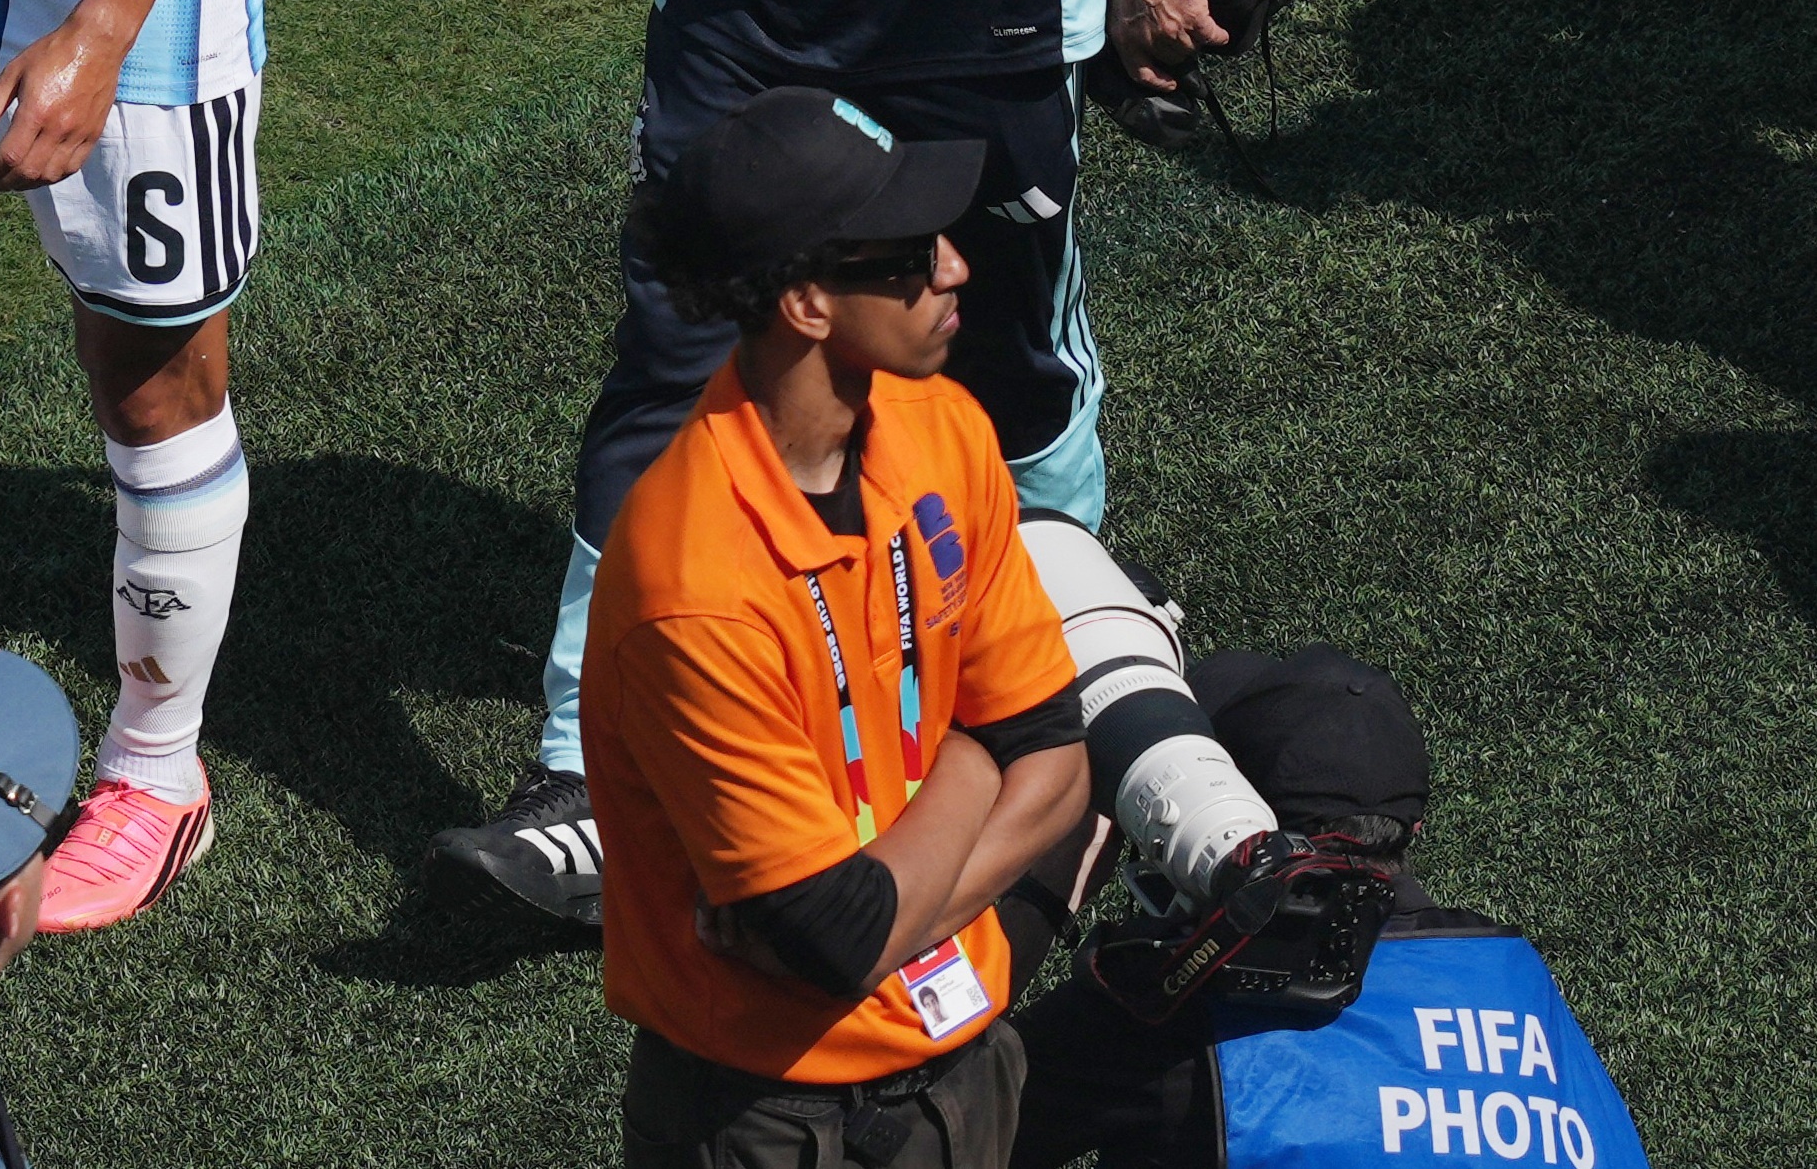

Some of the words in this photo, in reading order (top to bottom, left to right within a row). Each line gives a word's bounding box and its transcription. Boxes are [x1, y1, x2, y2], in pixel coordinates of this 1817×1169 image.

[125, 170, 185, 286] 6
[889, 530, 902, 549] C
[115, 578, 193, 621] AFA
[892, 548, 912, 613] WORLD
[815, 600, 833, 632] CUP
[900, 612, 913, 651] FIFA
[1163, 938, 1221, 996] Canon
[1413, 1007, 1558, 1085] FIFA
[1378, 1086, 1595, 1169] PHOTO
